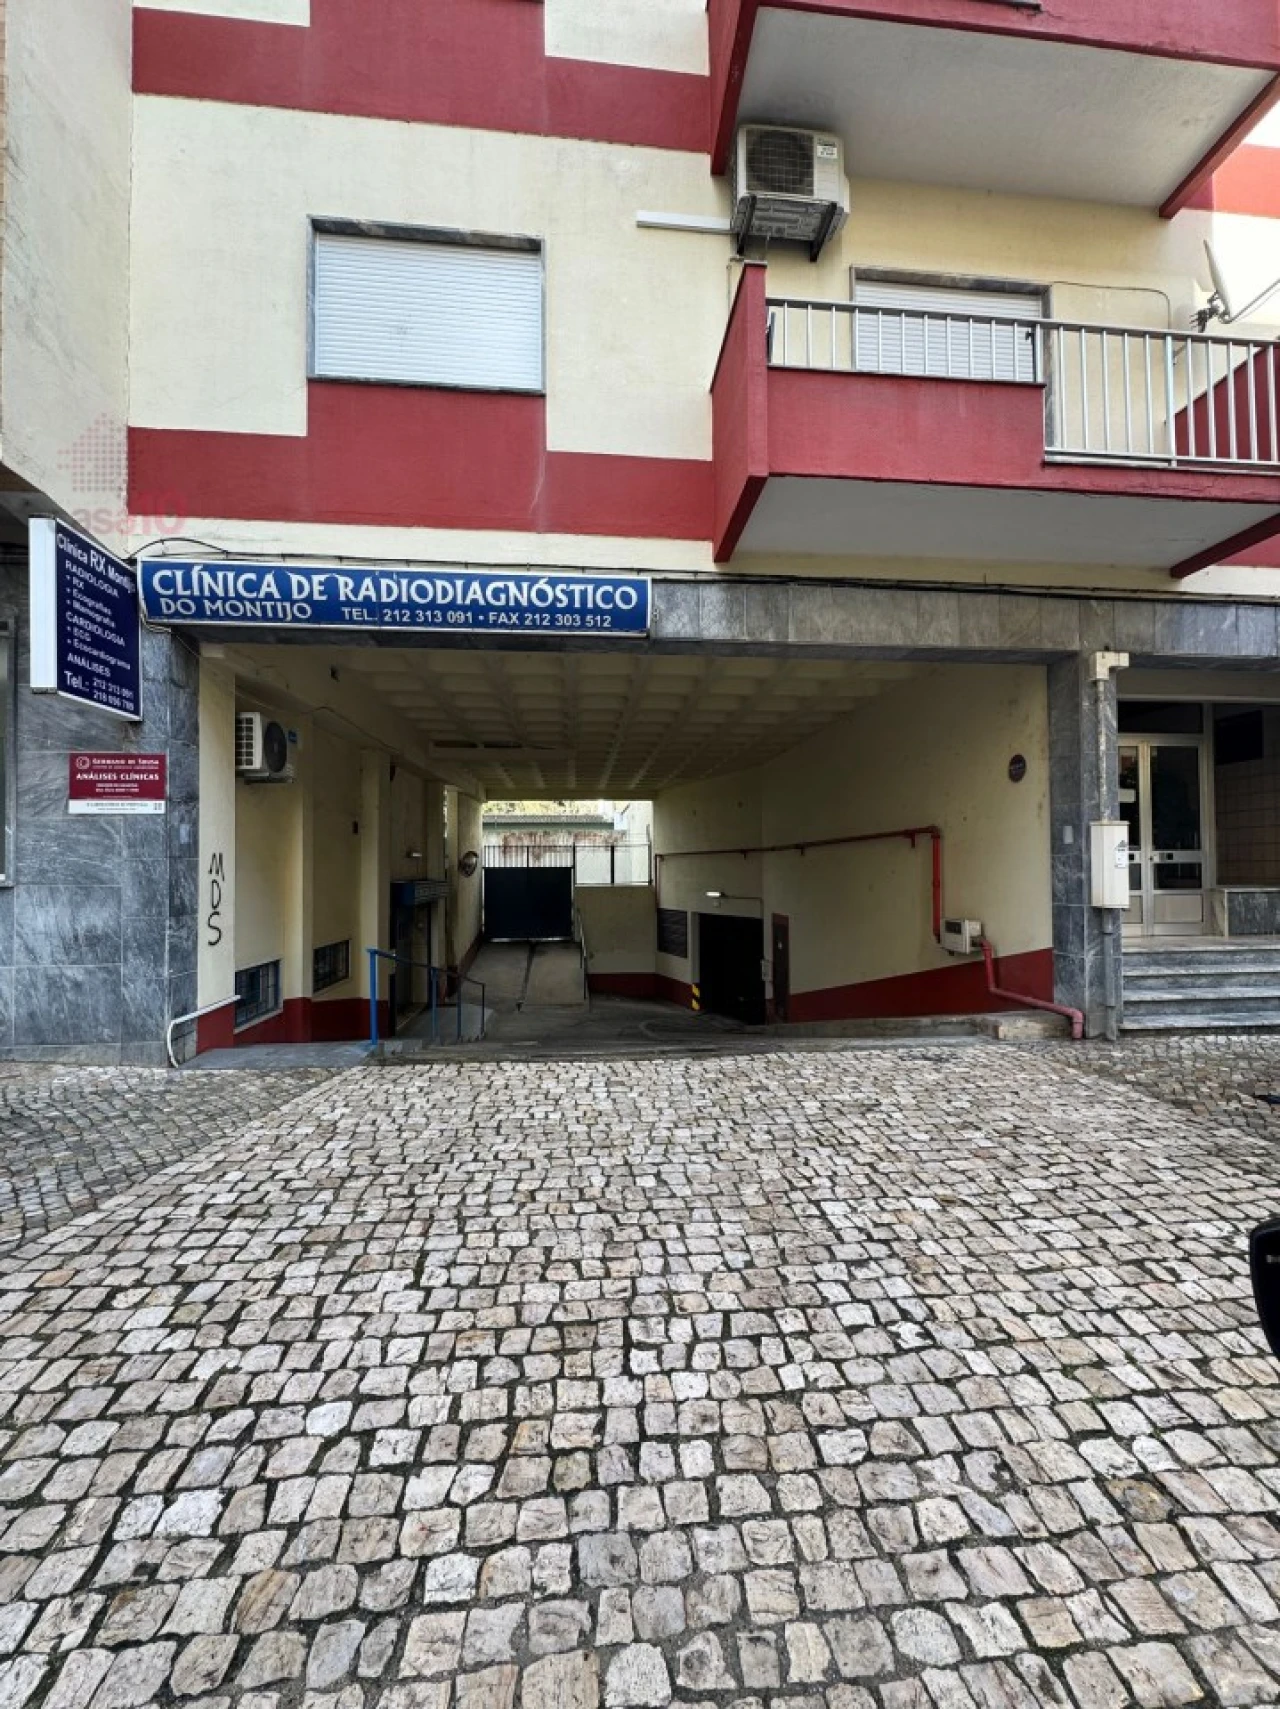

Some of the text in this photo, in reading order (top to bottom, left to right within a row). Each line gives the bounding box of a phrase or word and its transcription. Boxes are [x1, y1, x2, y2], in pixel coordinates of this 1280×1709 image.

[91, 550, 106, 575] RX
[65, 560, 119, 598] RADIOLOGIA
[152, 564, 639, 611] CLÍNICA DE RADIODIAGNÓSTICO
[161, 597, 312, 622] DO MONTIJO
[341, 607, 612, 627] TEL. 212 313 091 FAX 212 303 512
[66, 611, 125, 647] CARDIOLOGIA
[76, 770, 160, 780] ANÁLISES CLÍNICAS
